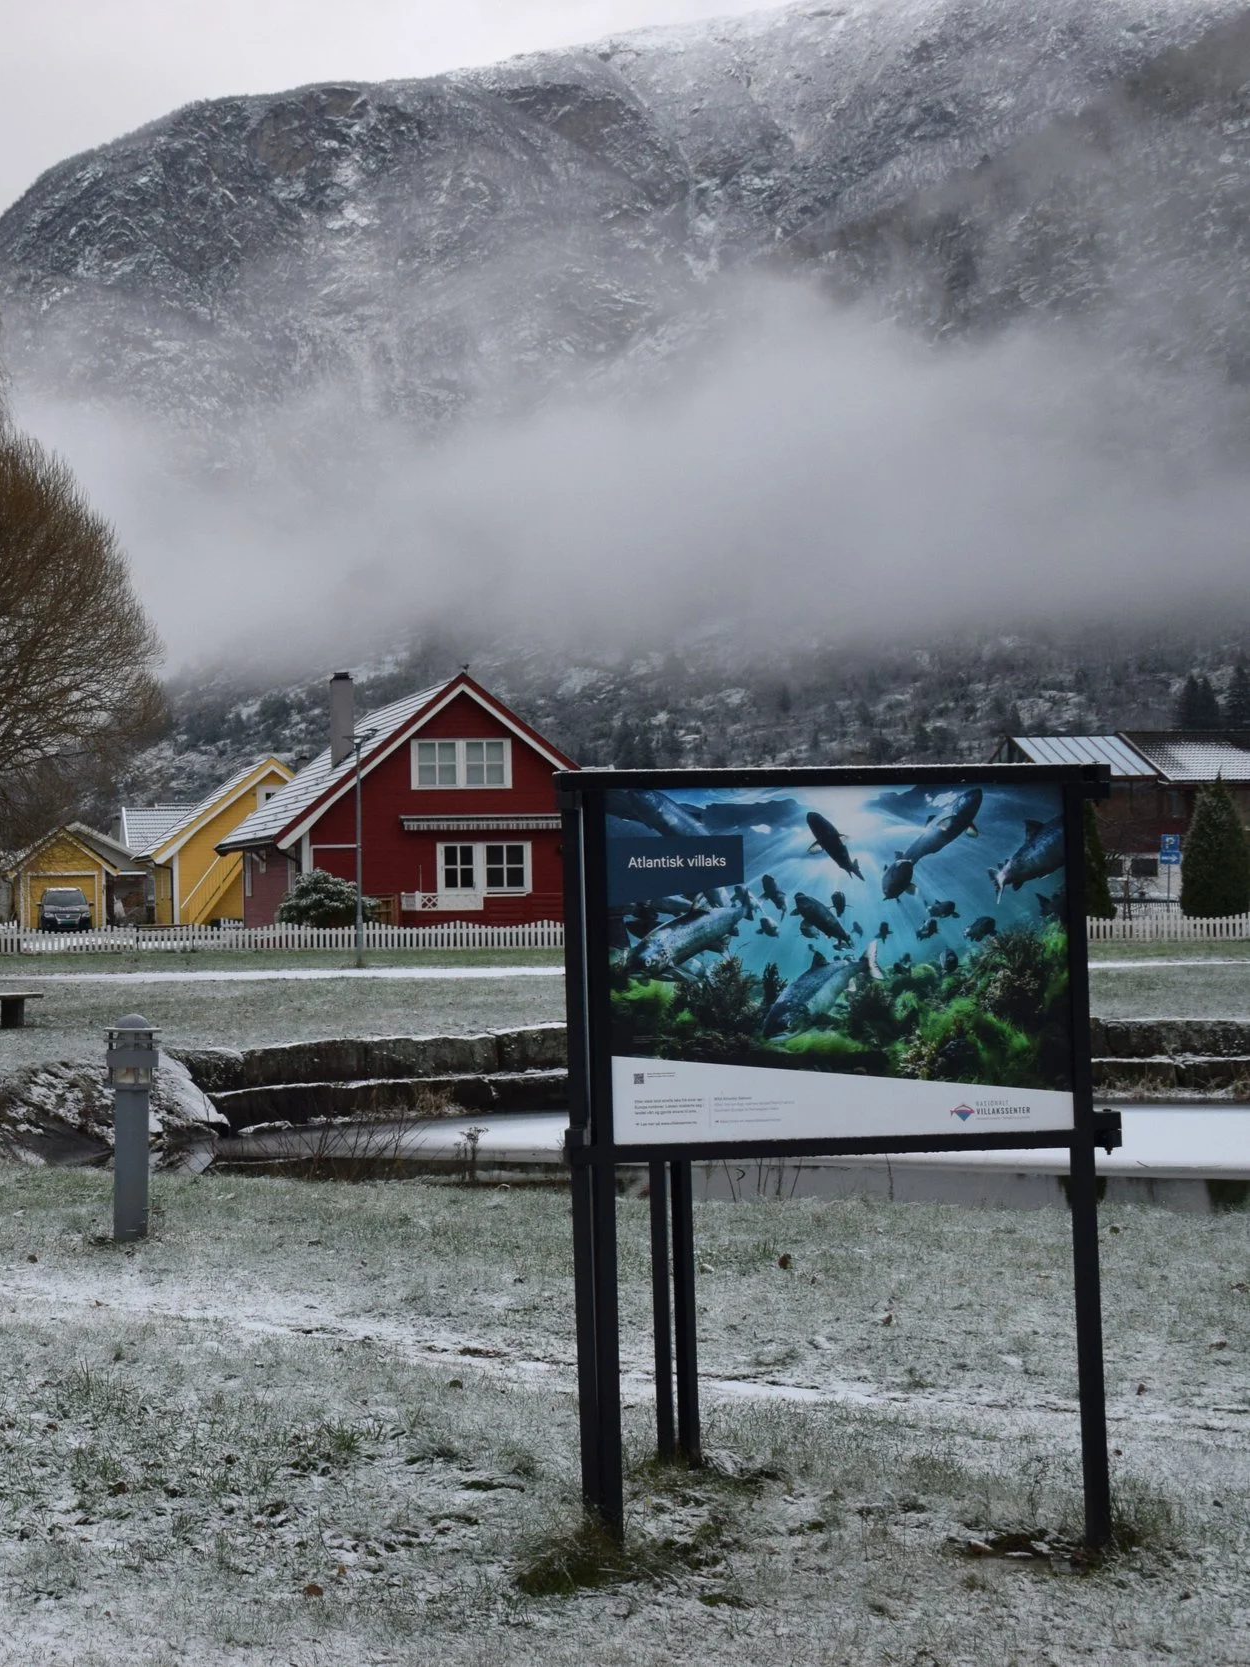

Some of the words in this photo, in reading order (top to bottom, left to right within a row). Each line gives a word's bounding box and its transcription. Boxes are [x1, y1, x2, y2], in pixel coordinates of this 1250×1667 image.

[628, 855, 684, 868] Atlantisk
[687, 854, 726, 867] villaks
[976, 1106, 1031, 1115] VILLAKSSENTER
